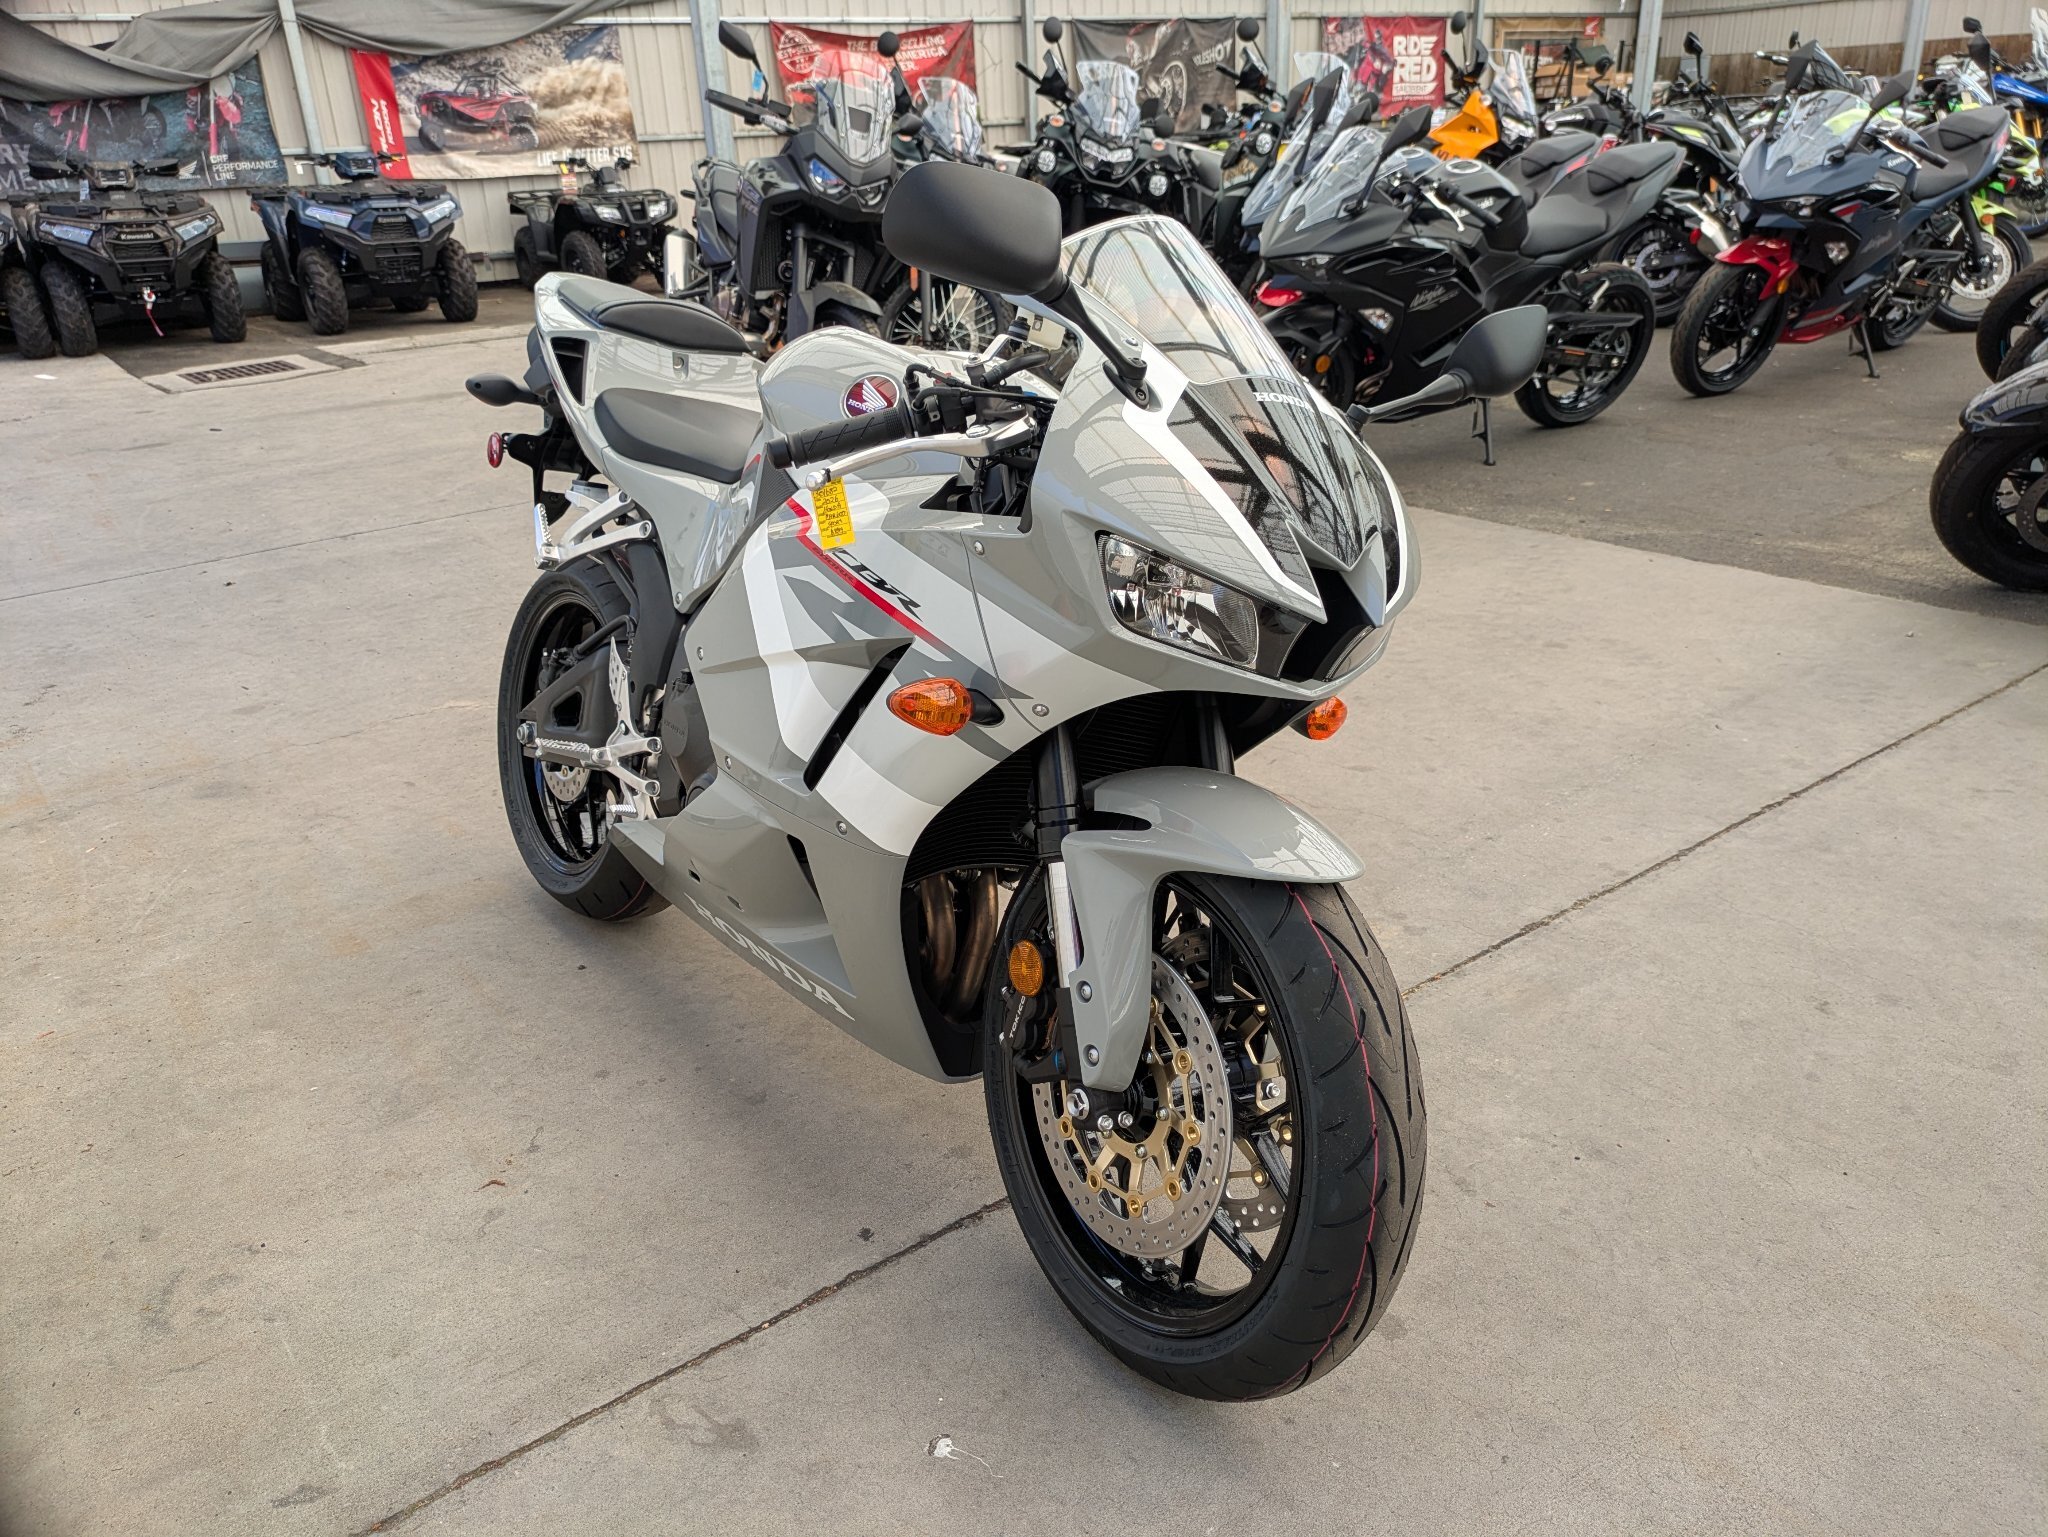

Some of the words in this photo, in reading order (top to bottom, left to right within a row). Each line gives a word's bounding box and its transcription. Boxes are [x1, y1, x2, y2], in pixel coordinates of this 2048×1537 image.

[847, 40, 868, 51] THE
[900, 35, 945, 50] SELLING
[1392, 35, 1439, 56] RIDE
[896, 46, 948, 61] AMERICA
[1392, 56, 1438, 83] RED
[210, 154, 229, 164] CRF
[213, 160, 279, 172] PERFORMANCE
[215, 171, 236, 181] LINE
[848, 399, 876, 413] HOND
[684, 892, 856, 1021] HONDA
[1009, 995, 1026, 1039] TOKICO
